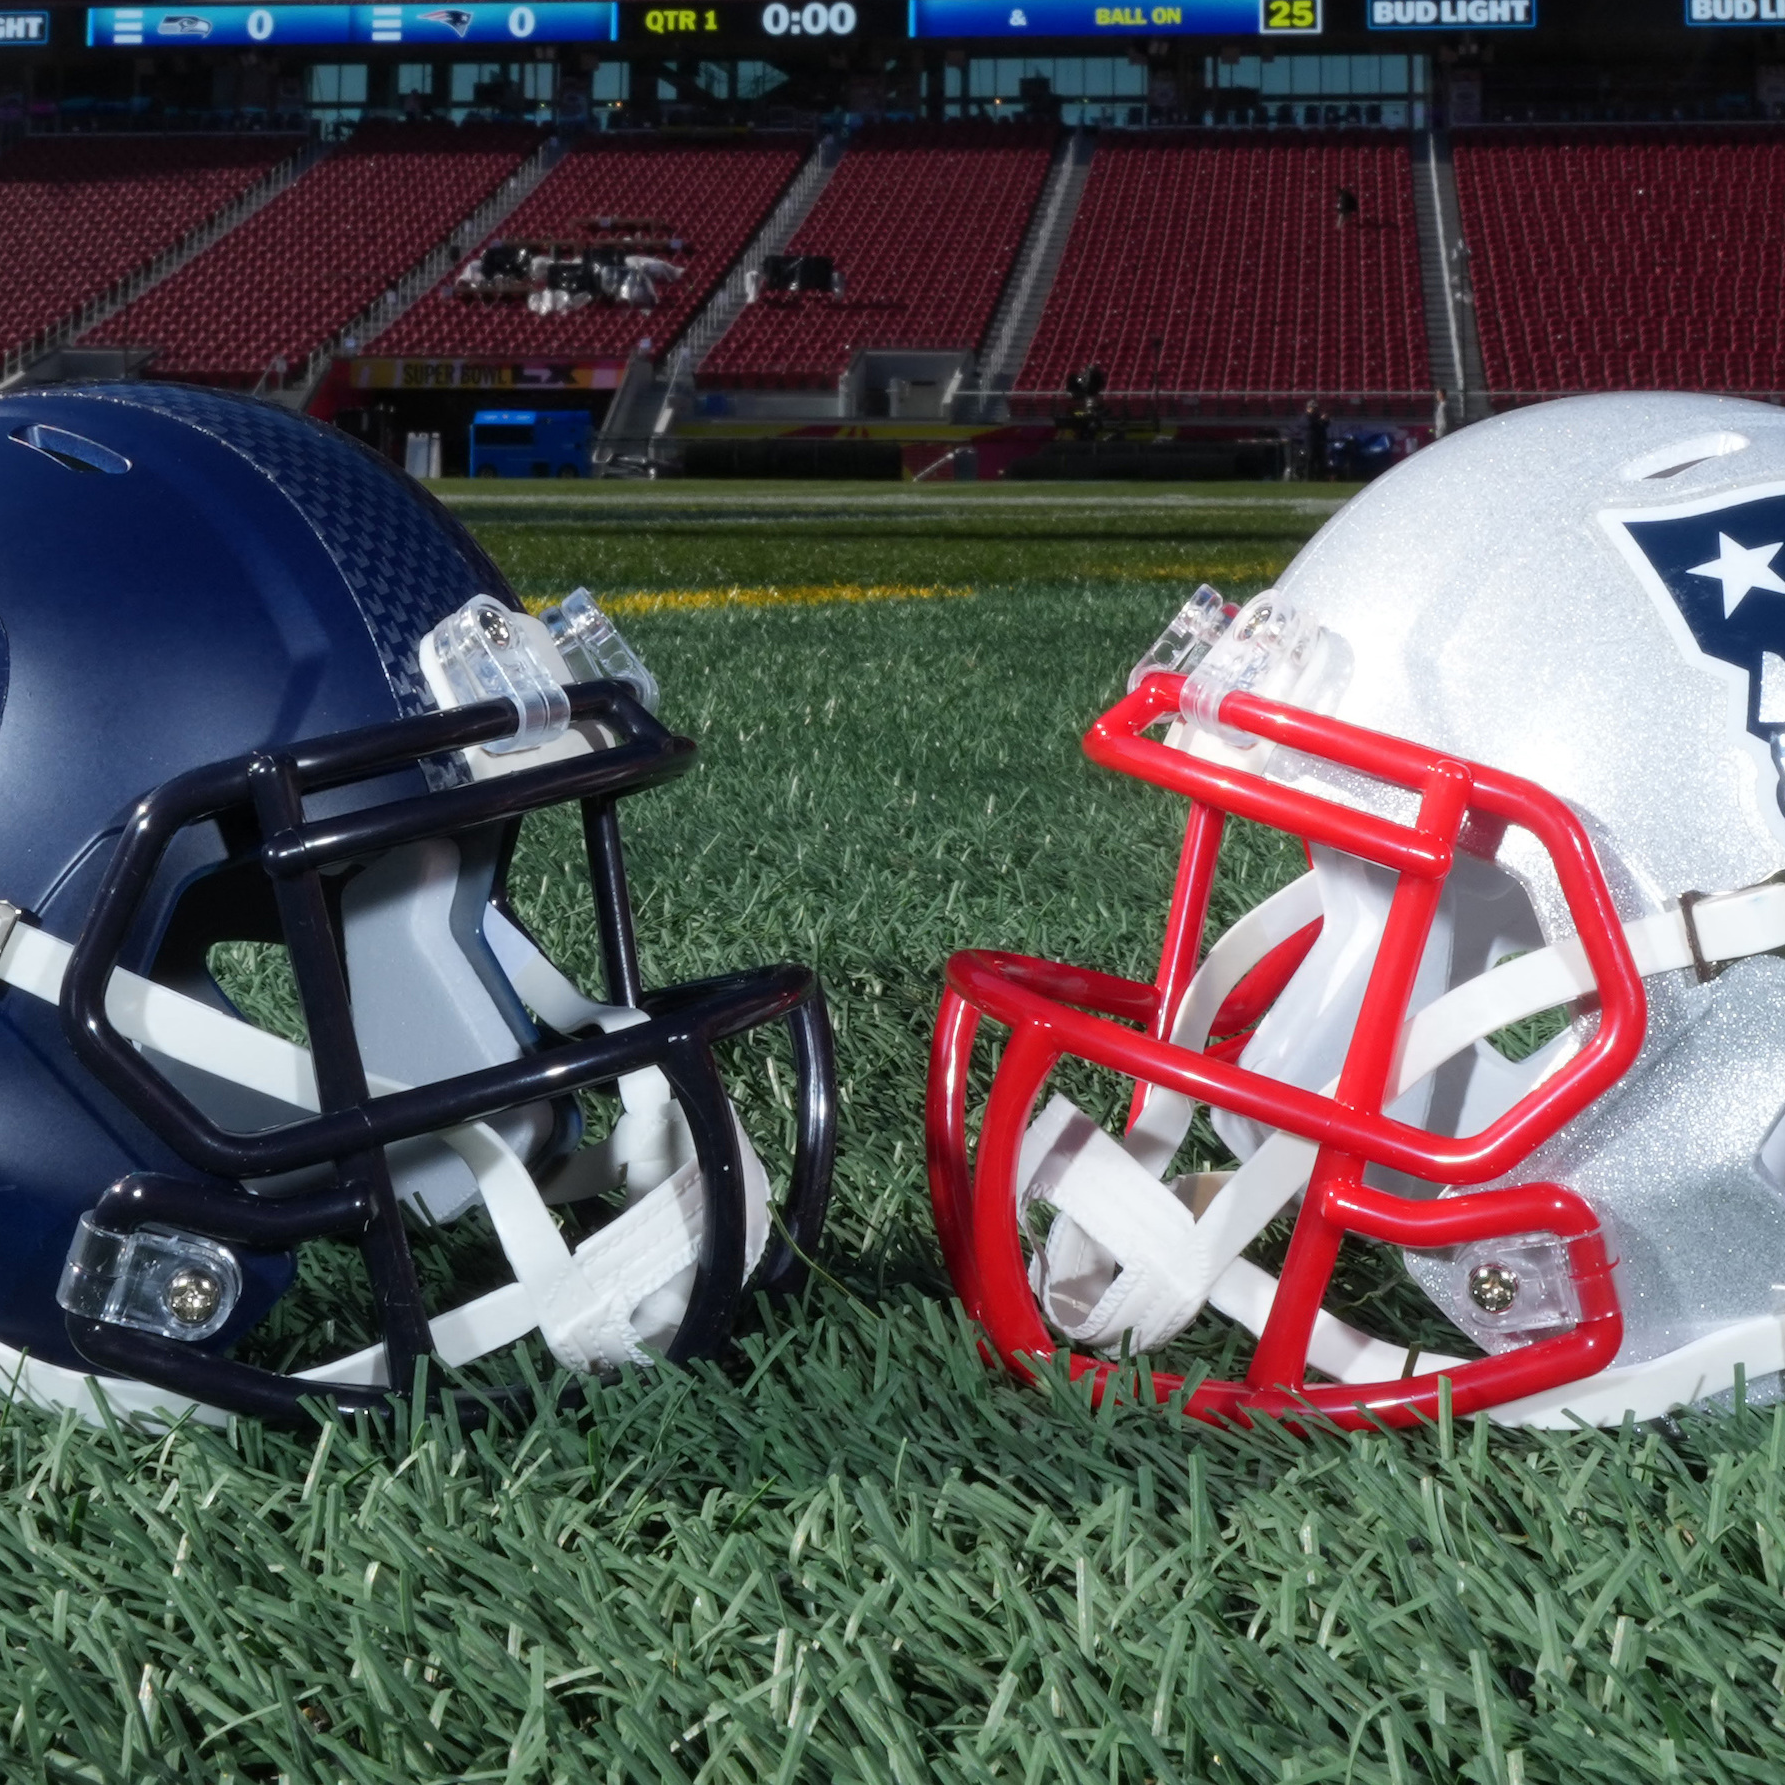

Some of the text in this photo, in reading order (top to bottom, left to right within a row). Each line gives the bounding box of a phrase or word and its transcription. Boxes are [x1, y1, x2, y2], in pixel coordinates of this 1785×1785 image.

[247, 9, 273, 41] 0
[508, 6, 536, 38] 0
[645, 10, 718, 34] QTR 1
[762, 1, 857, 36] 0:00
[1008, 8, 1028, 27] &
[1095, 0, 1314, 28] BALL ON 25
[1373, 0, 1439, 24] BUD
[402, 364, 454, 385] SUPER
[460, 364, 508, 385] BOWL
